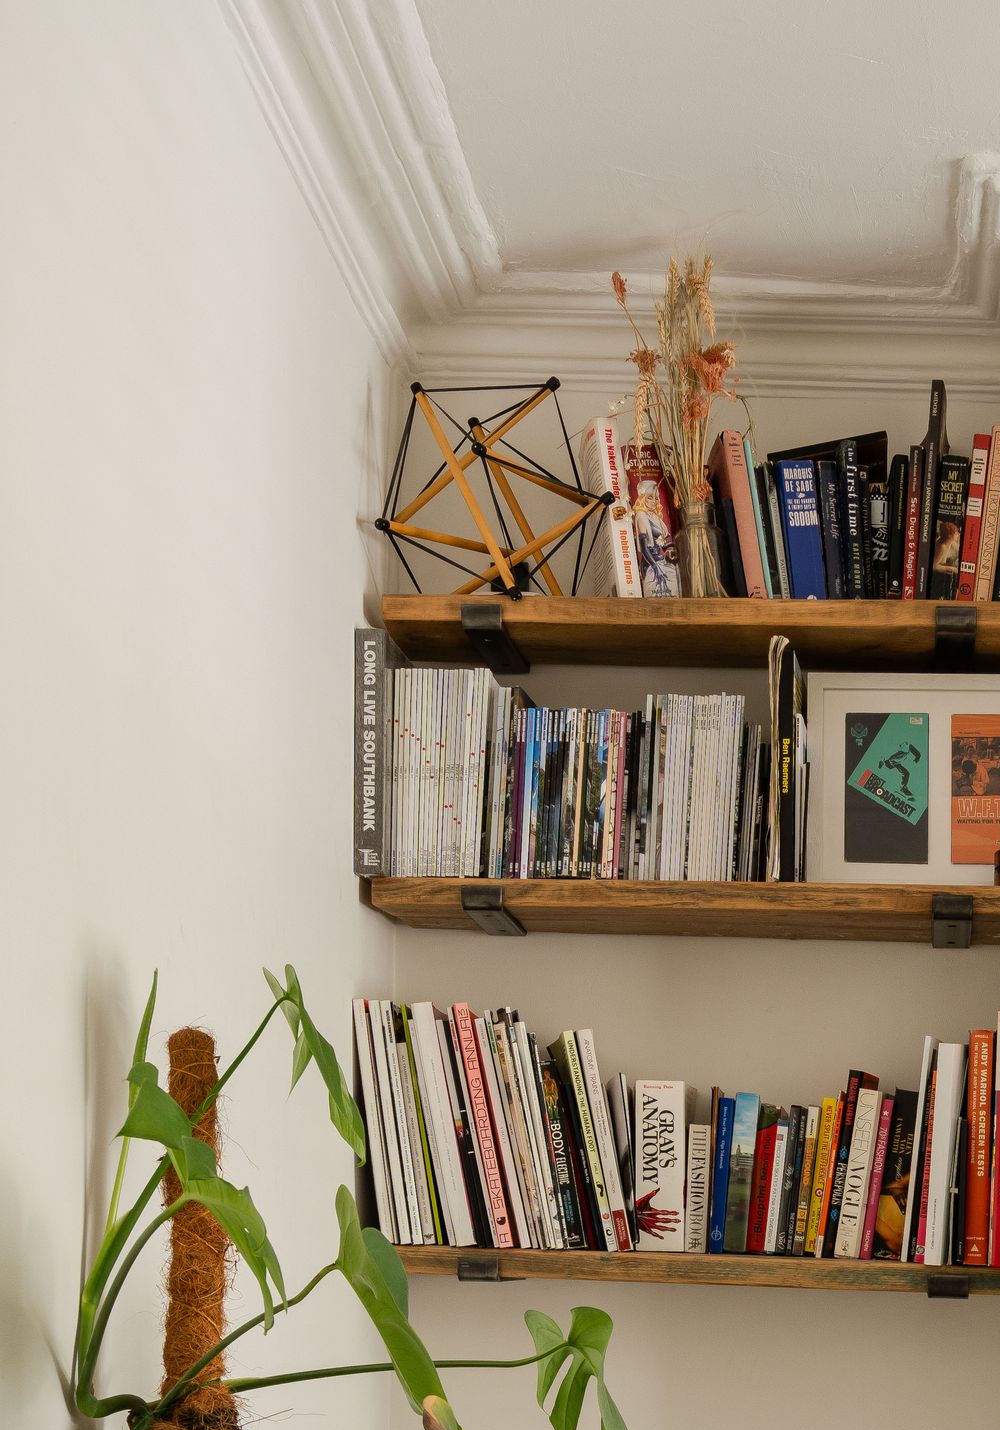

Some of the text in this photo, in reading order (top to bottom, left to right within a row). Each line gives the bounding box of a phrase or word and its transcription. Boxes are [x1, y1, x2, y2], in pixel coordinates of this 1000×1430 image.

[931, 391, 939, 417] MIDORI
[604, 428, 621, 500] The Naked Trader
[783, 467, 813, 480] MARQUIS
[948, 470, 959, 481] MY
[785, 480, 814, 492] DE SADE
[827, 482, 836, 494] My
[846, 465, 858, 499] first
[940, 481, 965, 493] SECRET
[789, 510, 818, 527] SODOM
[829, 497, 837, 523] Secret
[847, 503, 859, 536] time
[921, 486, 932, 543] JAPANESE BONDAGE
[830, 523, 840, 540] Life
[907, 517, 917, 541] Drugs
[908, 542, 916, 550] &
[620, 530, 633, 585] Robbie Burns
[852, 543, 861, 589] KATE MONRO
[905, 551, 915, 580] Magick
[362, 640, 377, 832] LONG LIVE SOUTHBANK
[782, 737, 791, 794] Ben Raemers
[461, 1008, 479, 1071] ANNUAL
[583, 1038, 599, 1096] ANATOMY TRAINS
[567, 1039, 596, 1154] UNDERSTANDING THE HUMAN FOOT
[976, 1041, 989, 1177] ANDY WARHOL SCREEN TESTS
[471, 1077, 505, 1209] SKATEBOARDING
[550, 1122, 565, 1157] BODY
[642, 1093, 659, 1185] ANATOMY
[658, 1109, 678, 1169] GRAY'S
[817, 1105, 833, 1185] NEVER SPLIT THE DIFFERENCE
[891, 1117, 903, 1154] UNWERTH
[898, 1139, 906, 1155] VON
[905, 1132, 914, 1156] ELLEN
[774, 1141, 783, 1167] TRICOLOR
[841, 1092, 876, 1227] UNSEEN VOGUE
[873, 1139, 887, 1174] FASHION
[556, 1157, 571, 1186] ELECTRIC
[772, 1167, 780, 1188] SKATES
[831, 1162, 848, 1206] PERSEPOLIS
[863, 1229, 871, 1252] TASCHEN
